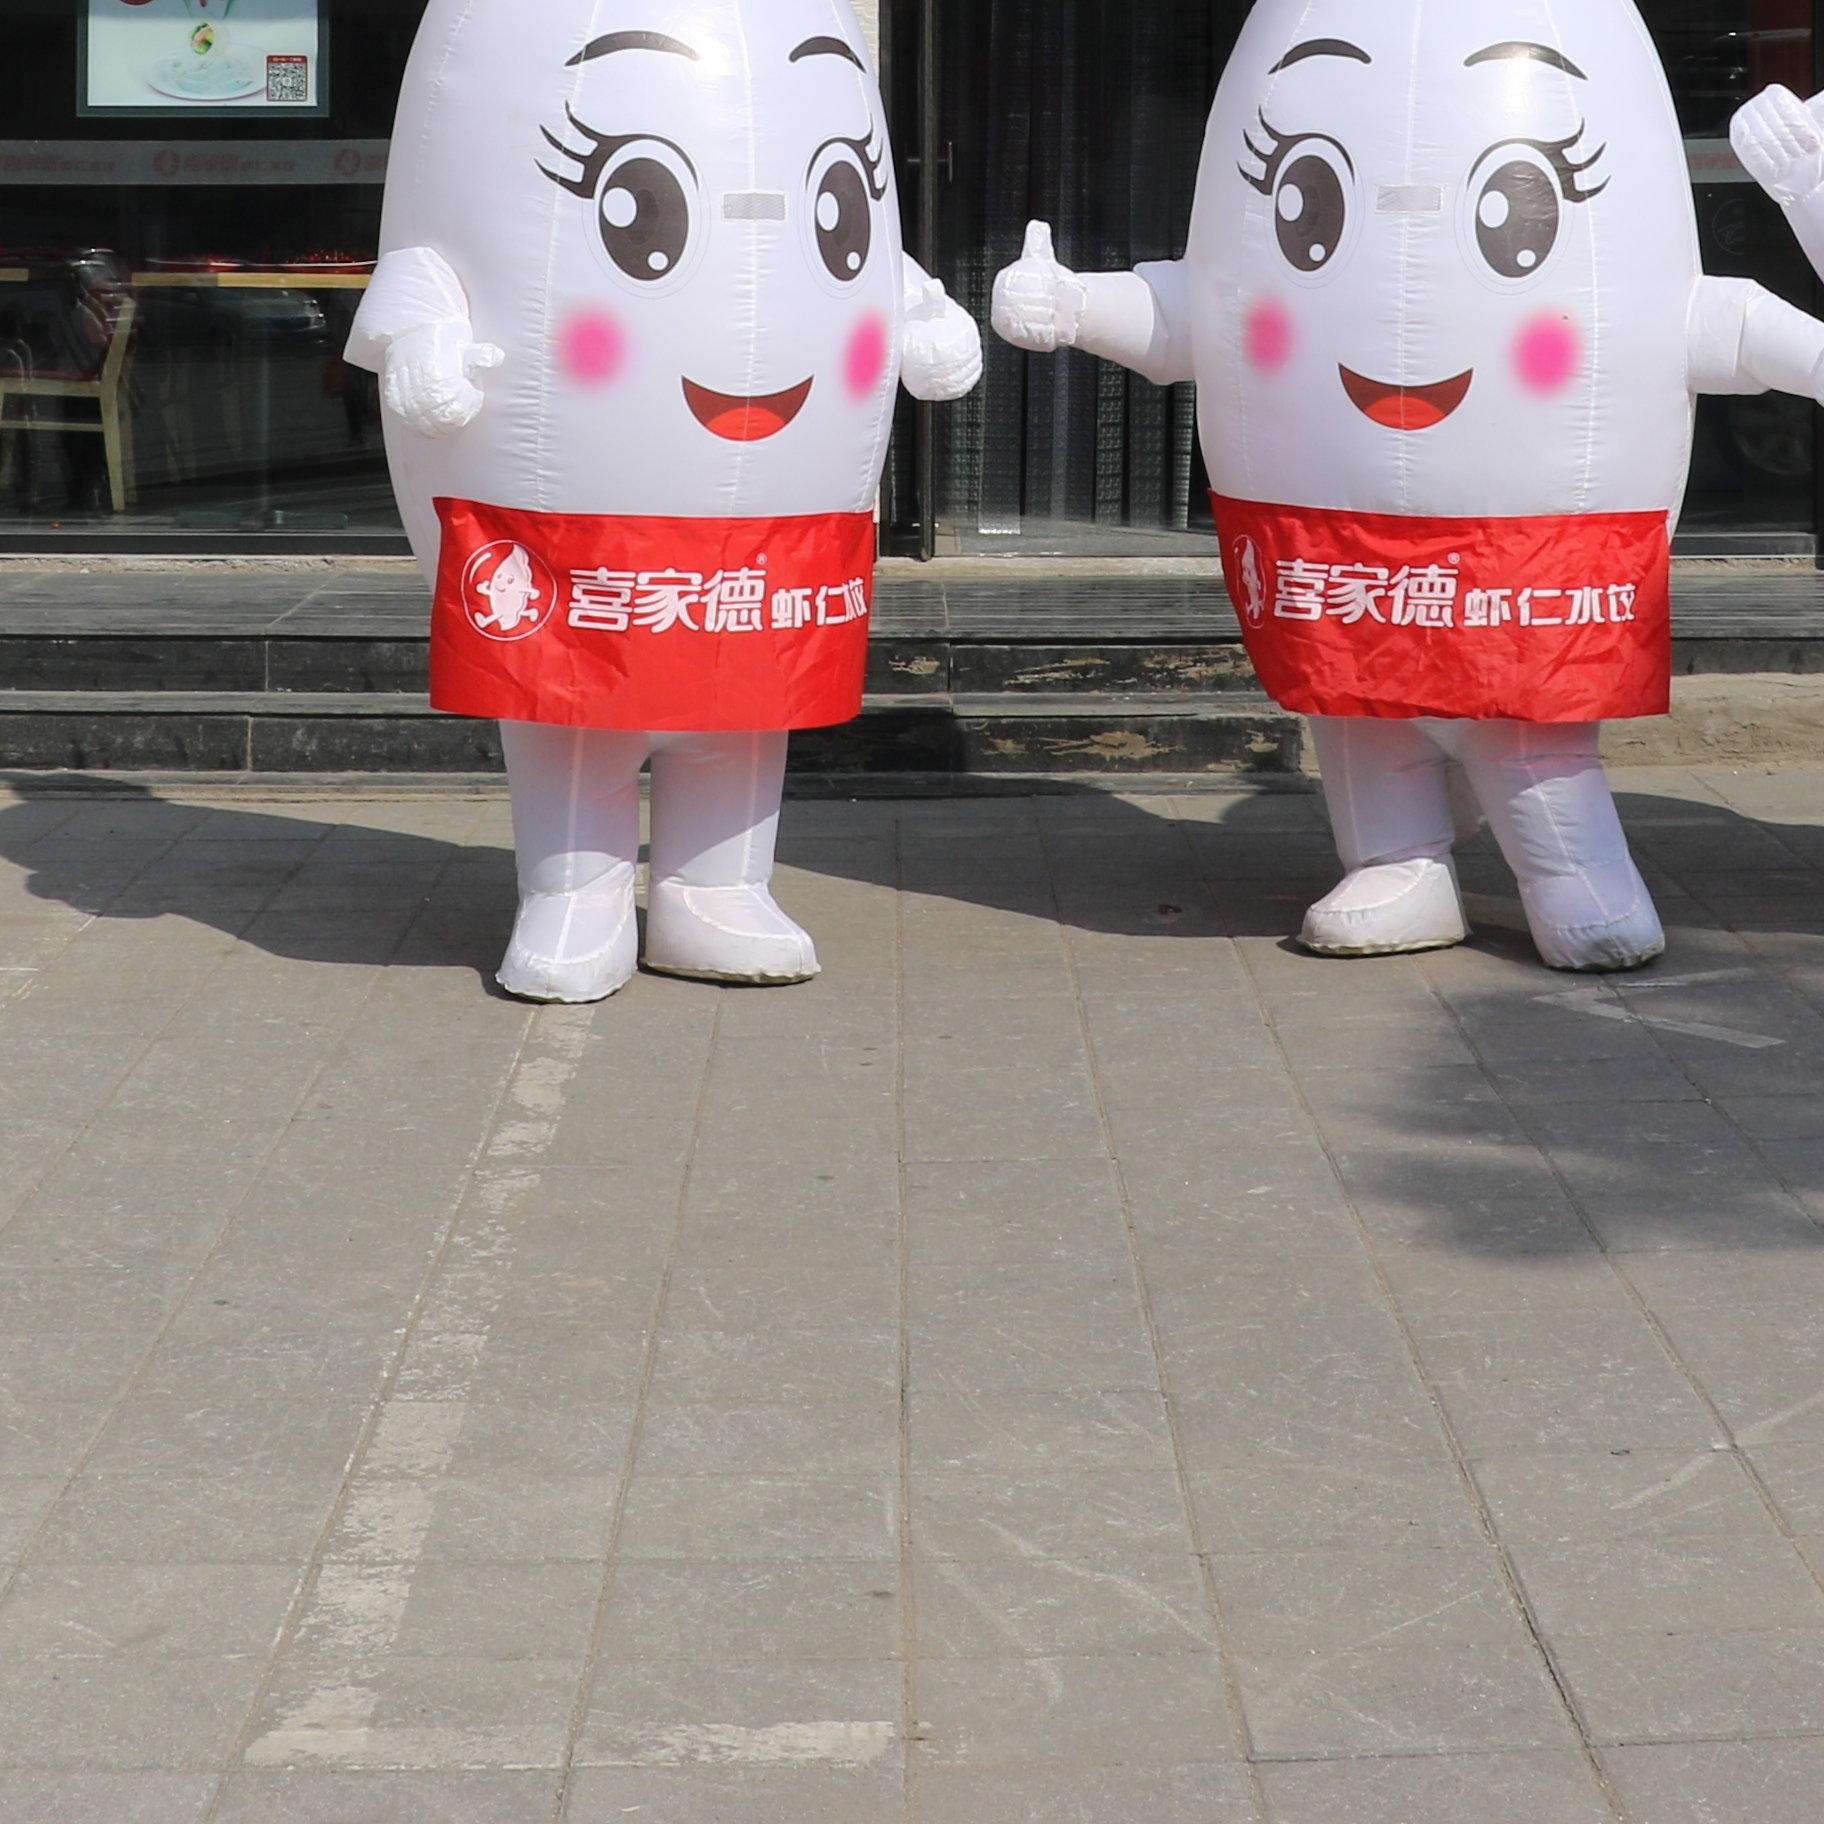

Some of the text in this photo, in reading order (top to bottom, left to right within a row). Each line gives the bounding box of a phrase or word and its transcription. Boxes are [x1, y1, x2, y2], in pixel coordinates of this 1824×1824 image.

[568, 566, 767, 633] 喜家德
[1273, 558, 1460, 628] 喜家德
[1463, 583, 1637, 627] 虾仁水饺
